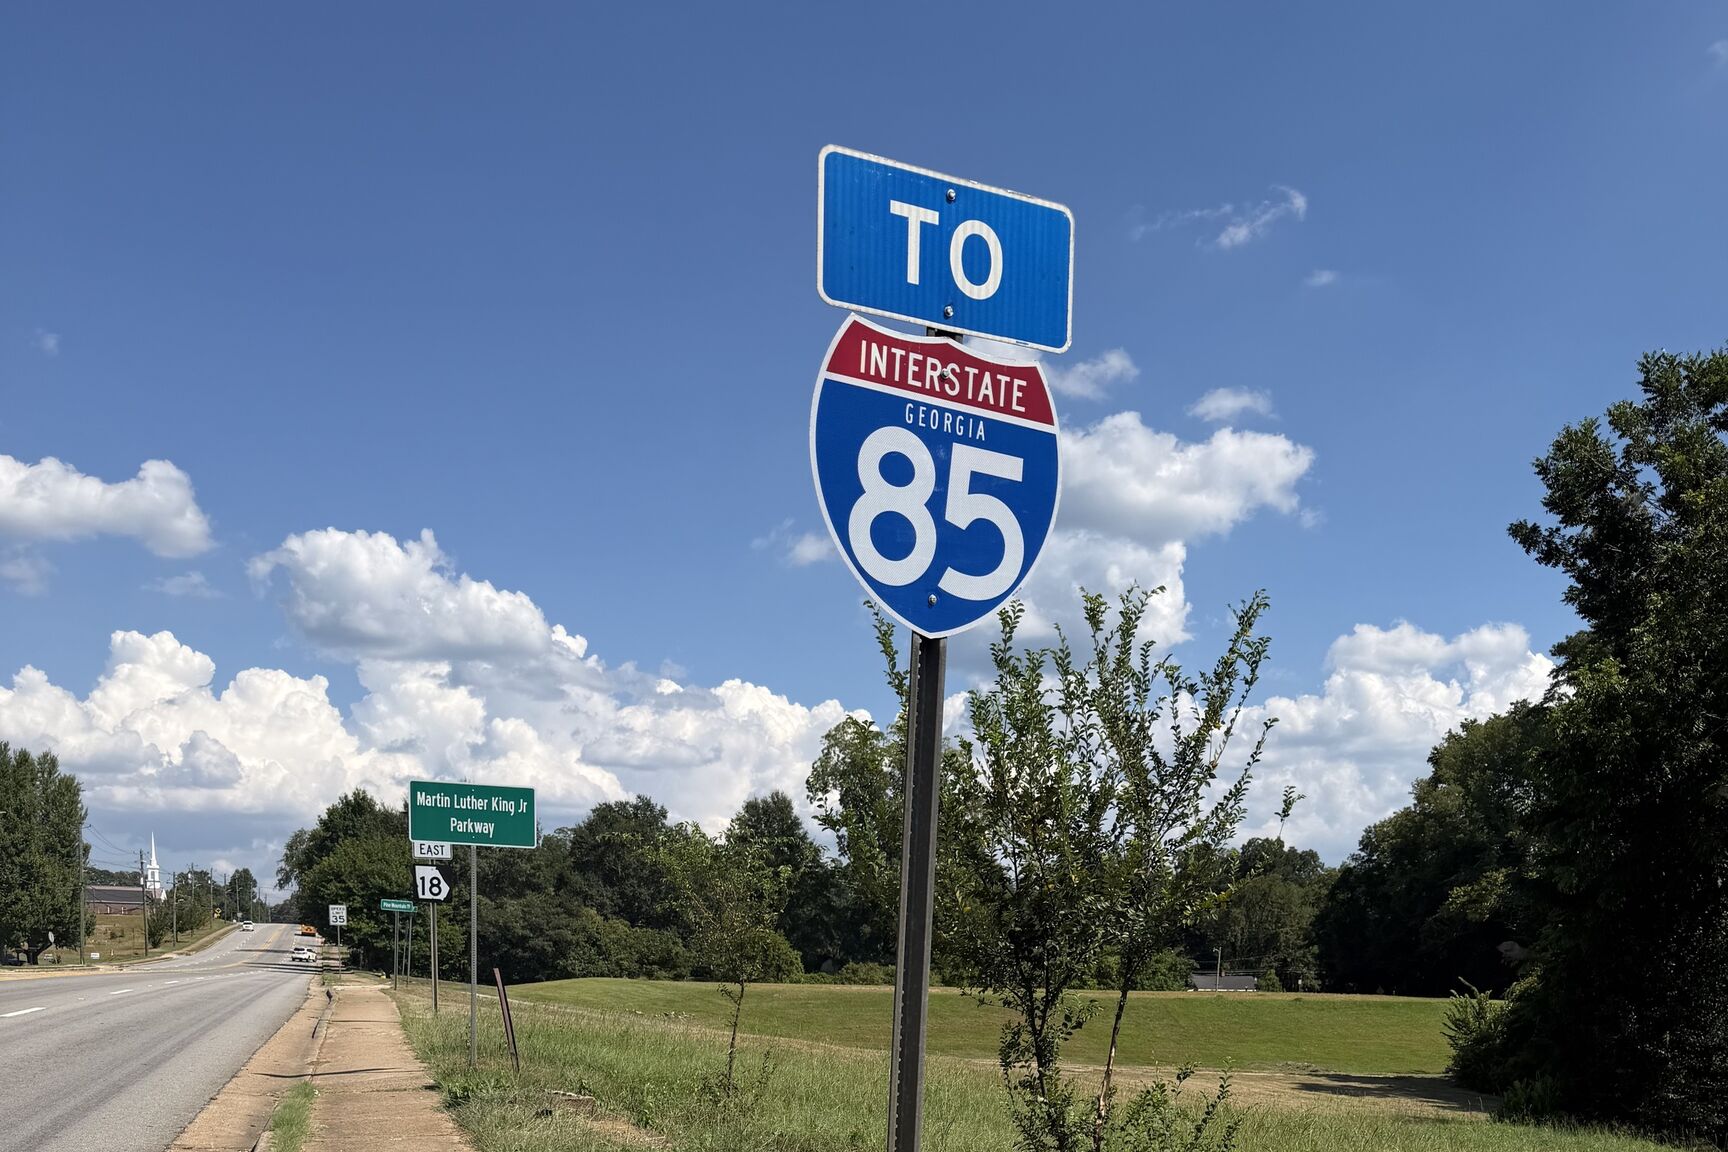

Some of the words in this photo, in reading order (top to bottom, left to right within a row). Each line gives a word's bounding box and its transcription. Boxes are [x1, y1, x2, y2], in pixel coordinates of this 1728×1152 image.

[889, 199, 1003, 300] TO
[860, 340, 1027, 413] INTERSTATE
[905, 403, 985, 441] GEORGIA
[848, 426, 1025, 602] 85
[416, 791, 451, 808] Martin
[454, 794, 488, 811] Luther
[491, 796, 515, 816] King
[518, 799, 528, 813] Jr
[450, 817, 495, 838] Parkway
[419, 843, 445, 856] EAST
[419, 876, 442, 897] 18
[331, 915, 345, 923] 35
